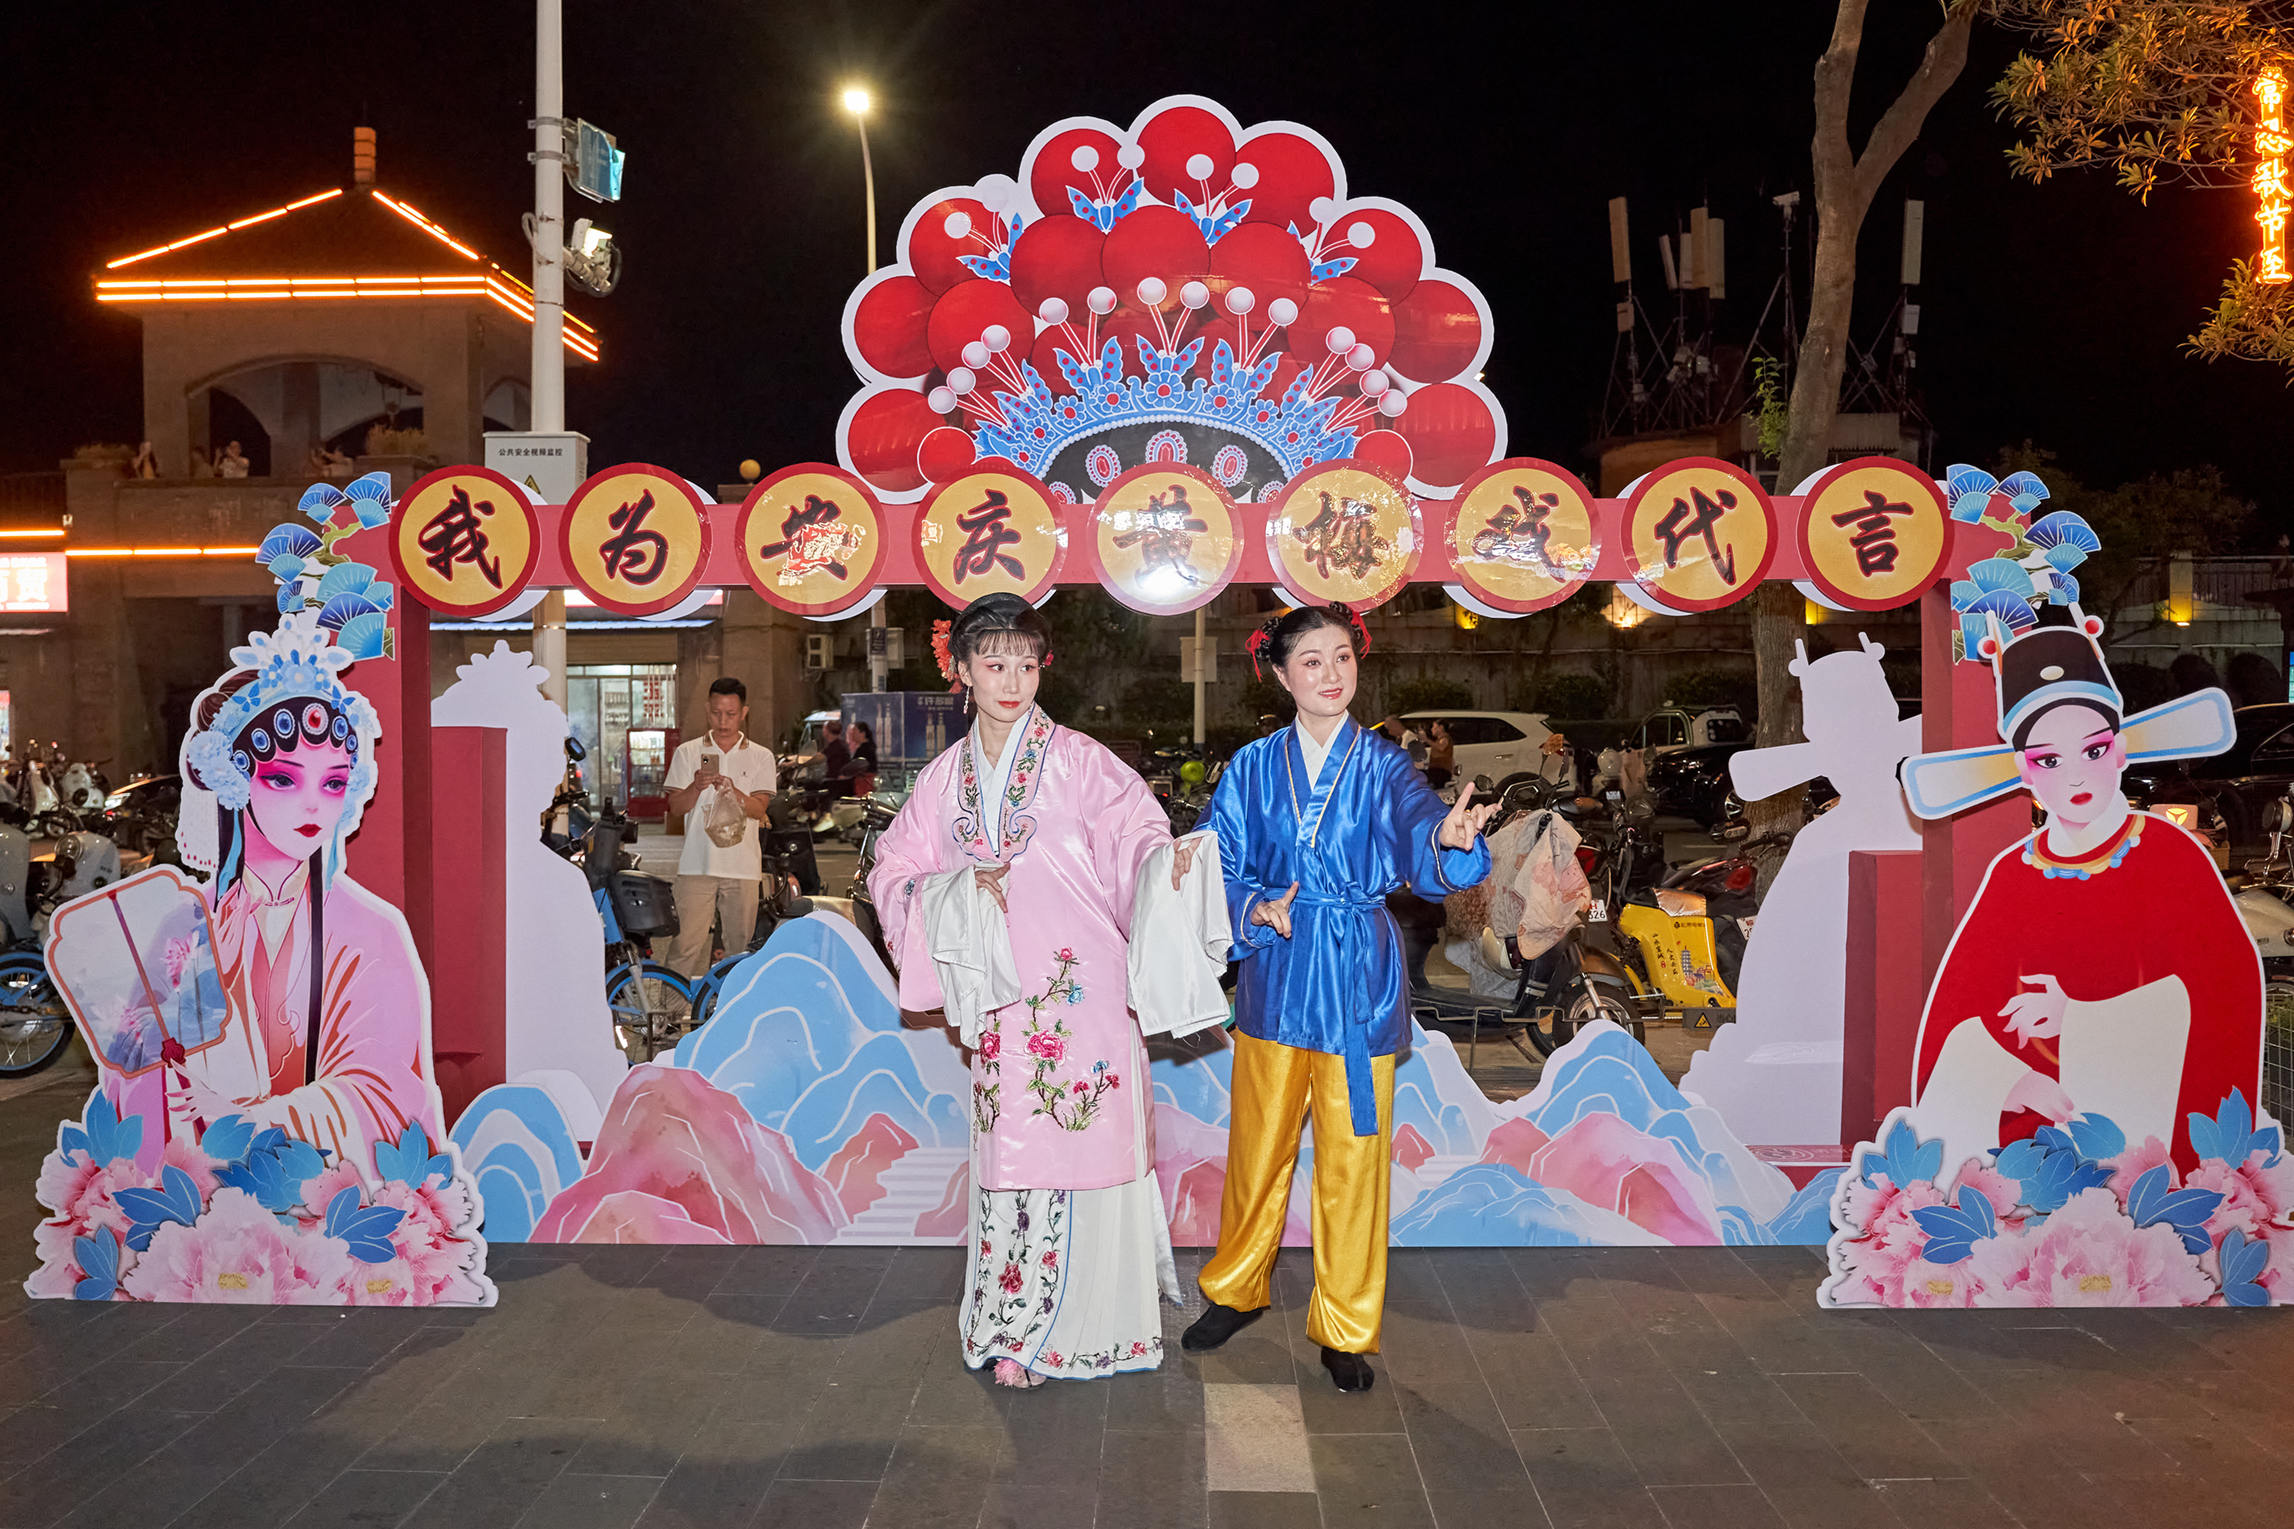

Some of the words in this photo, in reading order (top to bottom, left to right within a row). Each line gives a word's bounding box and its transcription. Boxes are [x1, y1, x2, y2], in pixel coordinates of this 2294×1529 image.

[499, 448, 563, 457] 公共安全视频监控
[1716, 1013, 1736, 1024] 当心
